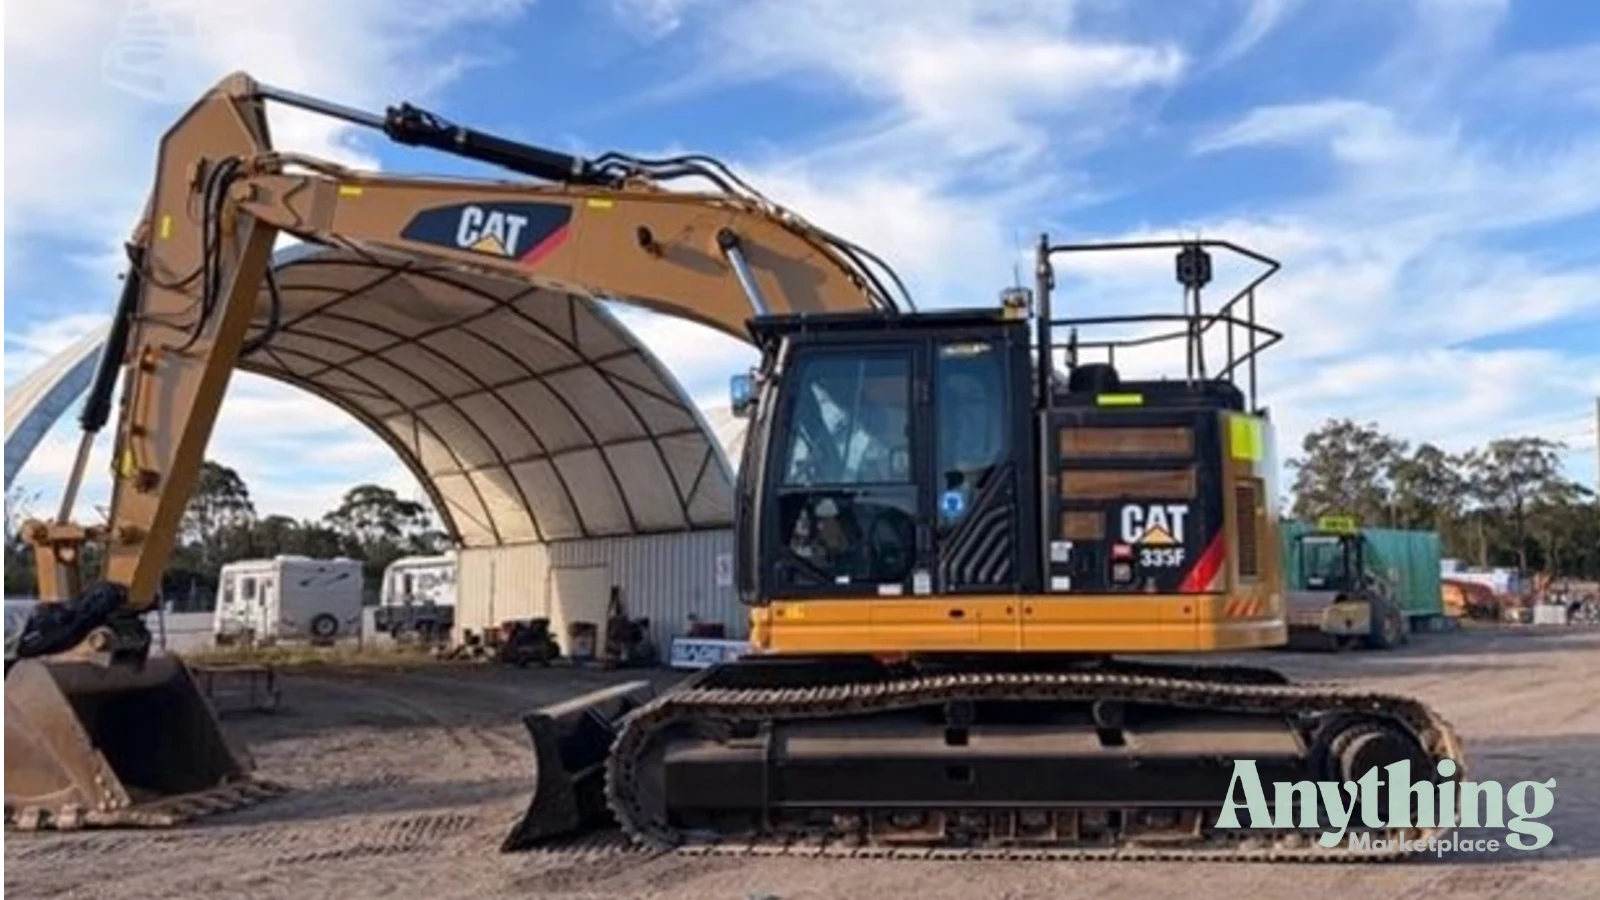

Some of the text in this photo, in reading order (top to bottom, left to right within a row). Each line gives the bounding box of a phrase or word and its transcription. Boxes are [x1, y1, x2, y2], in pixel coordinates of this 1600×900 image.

[456, 205, 528, 257] CAT
[1121, 504, 1189, 544] CAT
[1139, 548, 1185, 567] 335F
